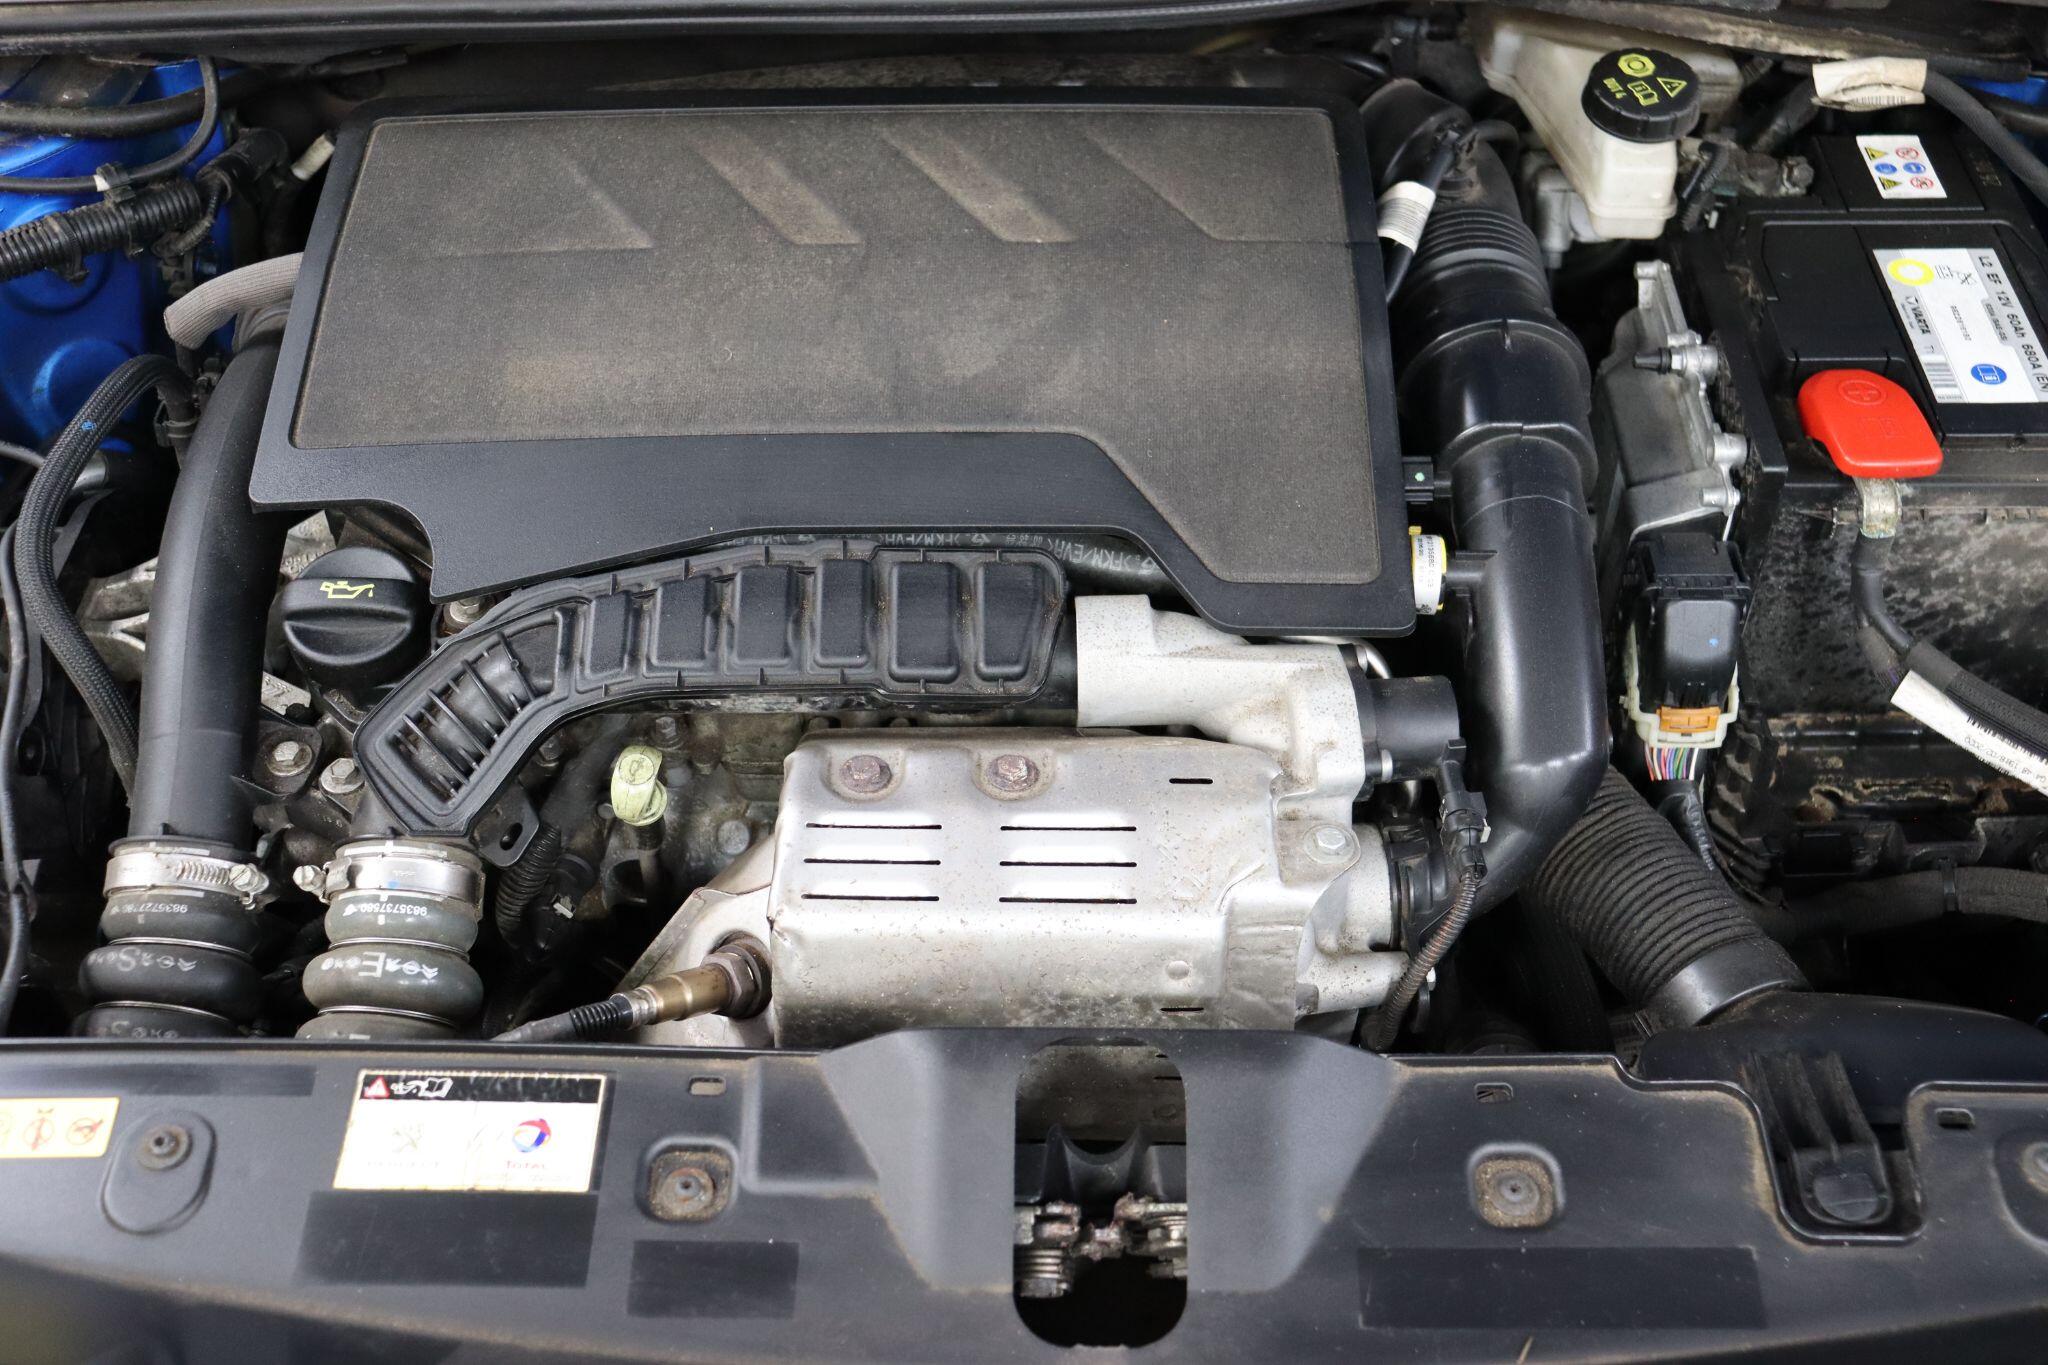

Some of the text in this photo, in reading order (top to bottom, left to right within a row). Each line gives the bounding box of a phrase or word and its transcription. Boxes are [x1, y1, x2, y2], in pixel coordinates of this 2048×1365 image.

[1911, 306, 1931, 335] VARTA
[1978, 256, 1993, 267] L2
[1987, 273, 2002, 285] EF
[1996, 290, 2014, 308] 12V
[2006, 313, 2025, 339] 60Ah
[2022, 344, 2043, 370] 680A
